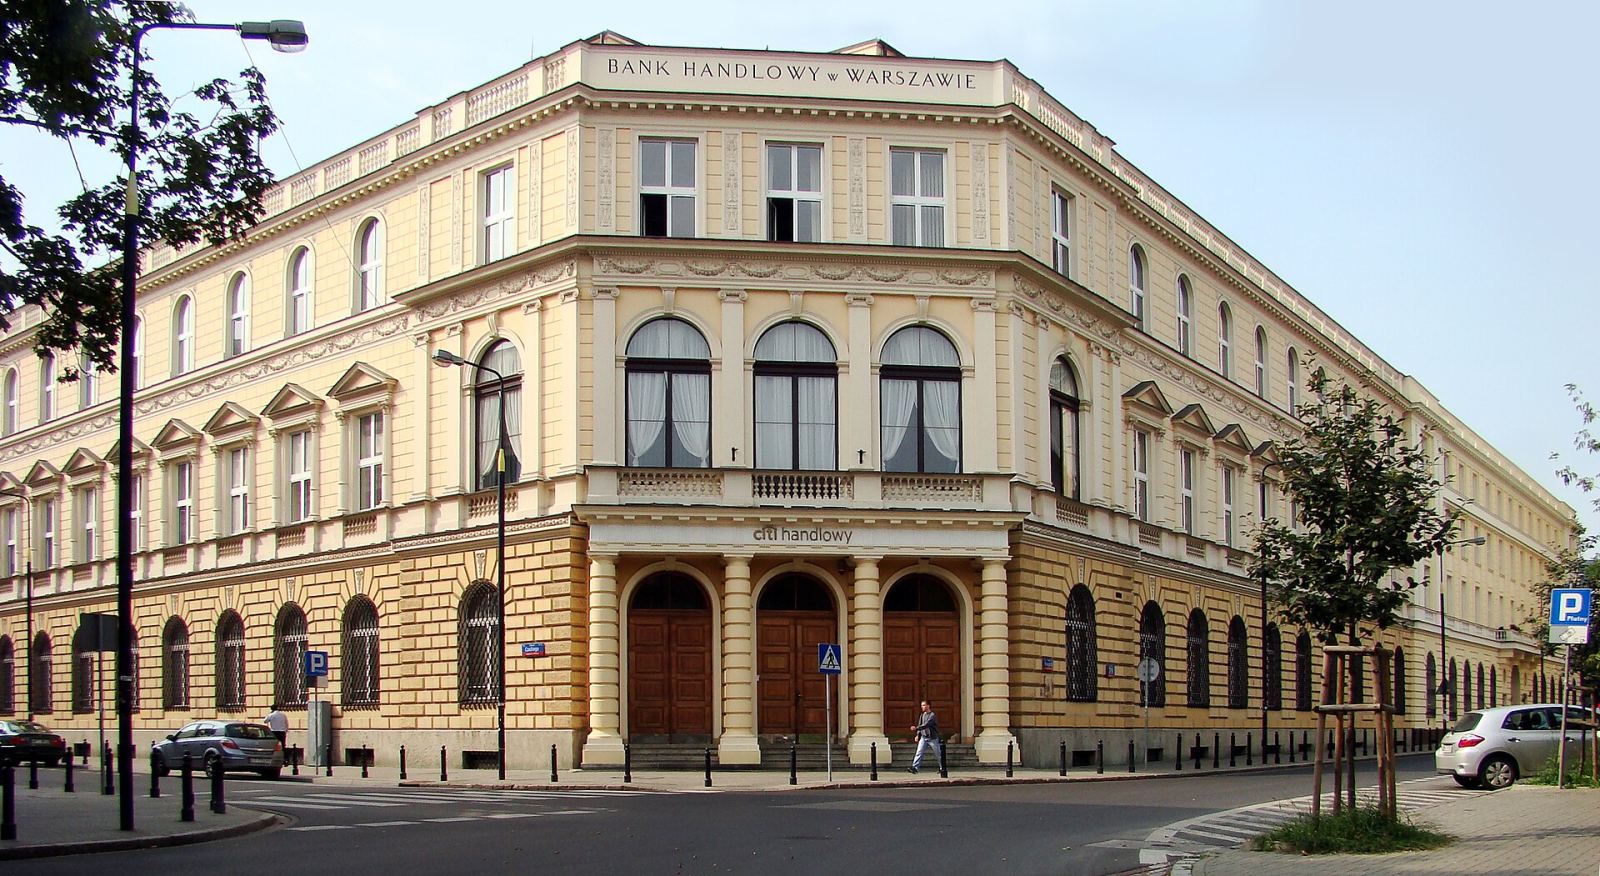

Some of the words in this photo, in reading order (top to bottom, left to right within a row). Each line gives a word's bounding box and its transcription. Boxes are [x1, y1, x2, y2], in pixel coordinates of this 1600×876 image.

[608, 58, 670, 76] BANK
[683, 61, 820, 82] HANDLOWY
[846, 68, 976, 89] WARSZAWIE
[753, 525, 777, 541] citi
[781, 527, 852, 544] handlowy
[1559, 593, 1582, 621] P
[311, 653, 324, 673] P
